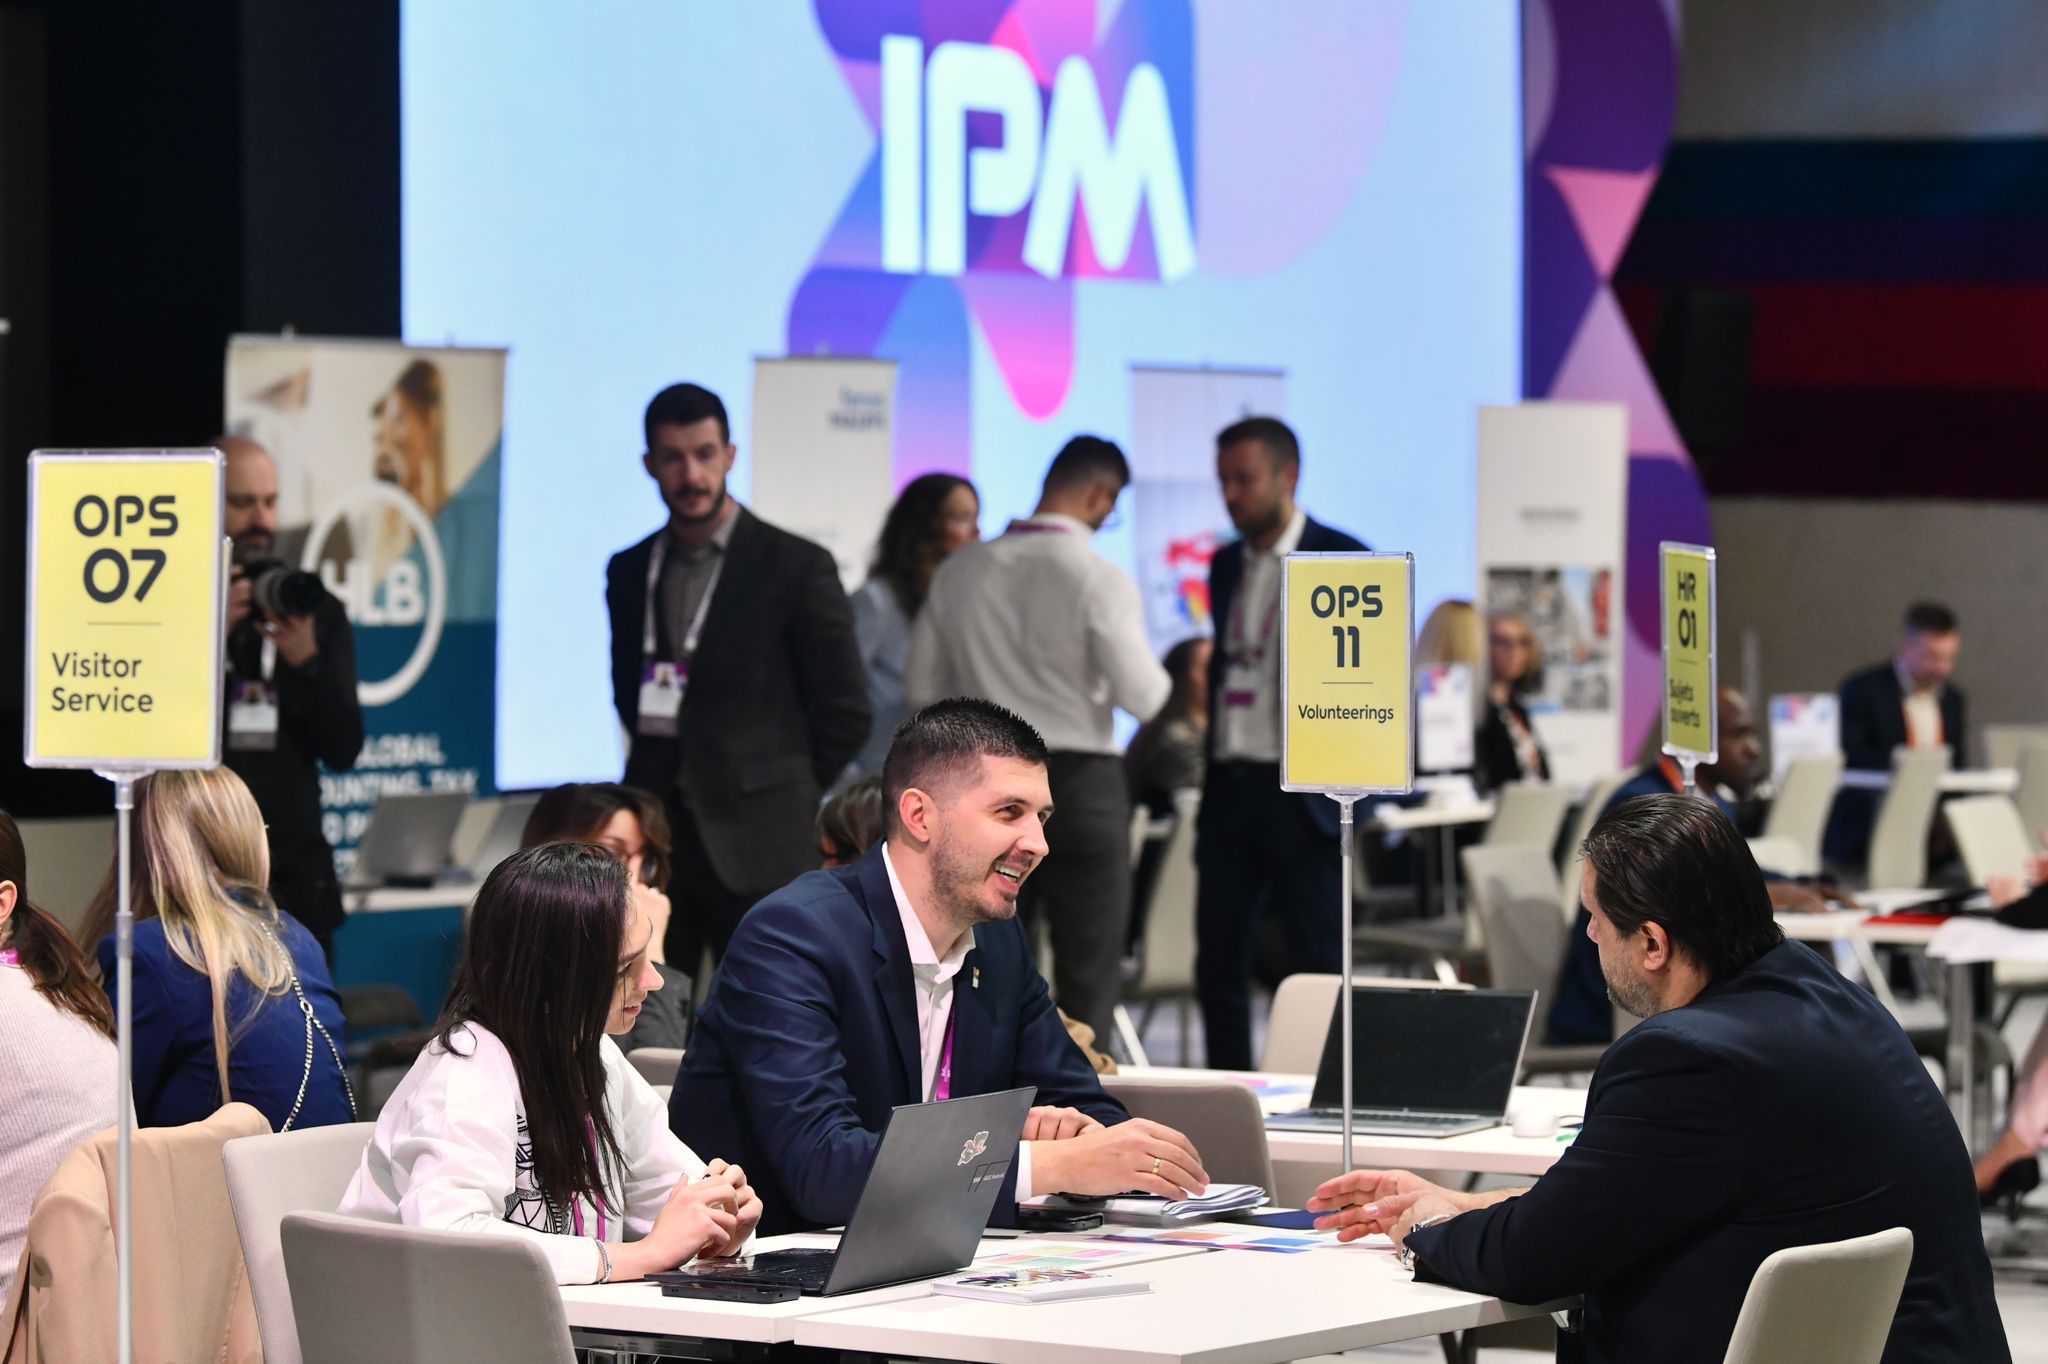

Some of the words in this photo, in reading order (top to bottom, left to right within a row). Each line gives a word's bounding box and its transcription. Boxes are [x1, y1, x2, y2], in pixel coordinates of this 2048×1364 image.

[881, 34, 1196, 281] IPM
[73, 494, 179, 538] OPS
[83, 547, 168, 604] 07
[320, 558, 424, 627] HLB
[1677, 571, 1697, 602] HR
[1310, 584, 1383, 619] OPS
[1332, 625, 1360, 668] 11
[1677, 607, 1697, 649] 01
[52, 652, 142, 678] Visitor
[52, 687, 153, 713] Service
[1298, 704, 1394, 724] Volunteerings
